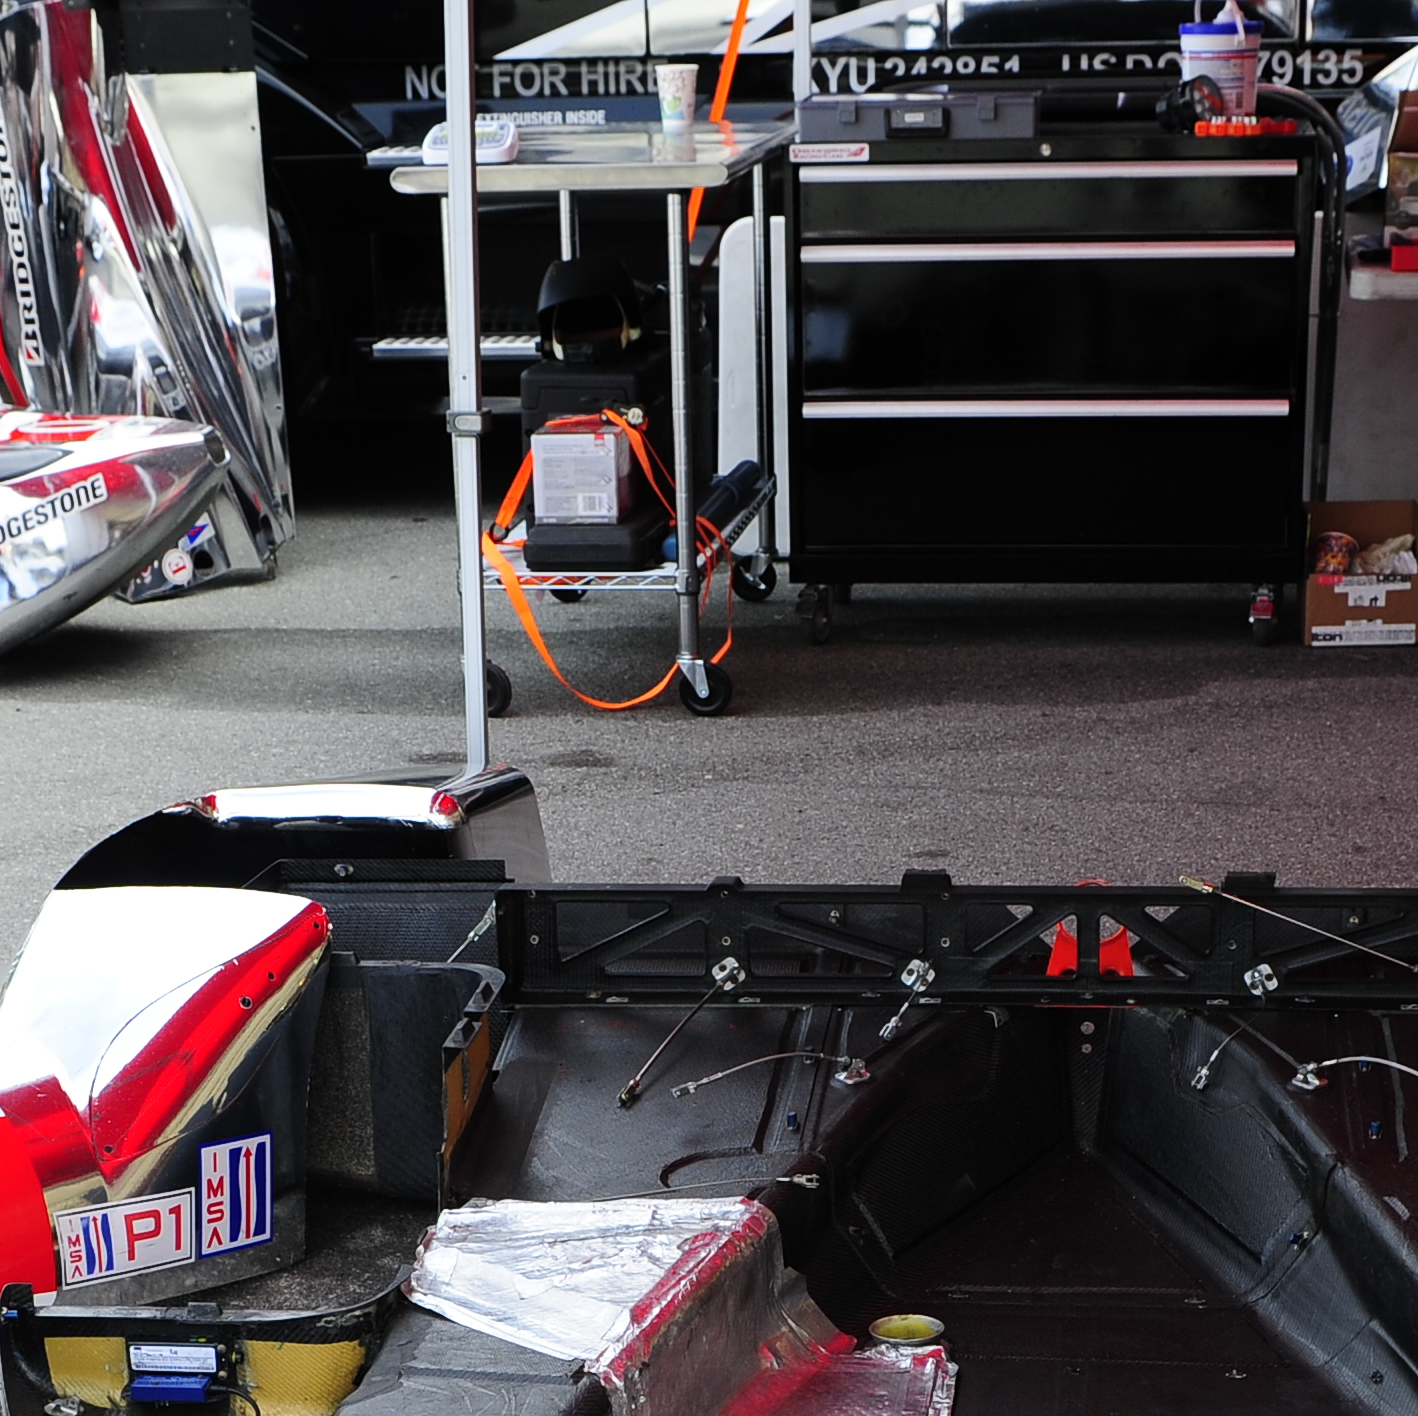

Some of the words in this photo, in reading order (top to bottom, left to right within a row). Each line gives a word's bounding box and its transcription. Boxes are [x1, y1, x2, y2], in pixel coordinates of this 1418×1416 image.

[492, 60, 569, 98] FOR
[581, 58, 668, 95] HIRE
[566, 109, 606, 125] INSIDE
[207, 1151, 225, 1250] IMSA
[124, 1204, 182, 1262] P1
